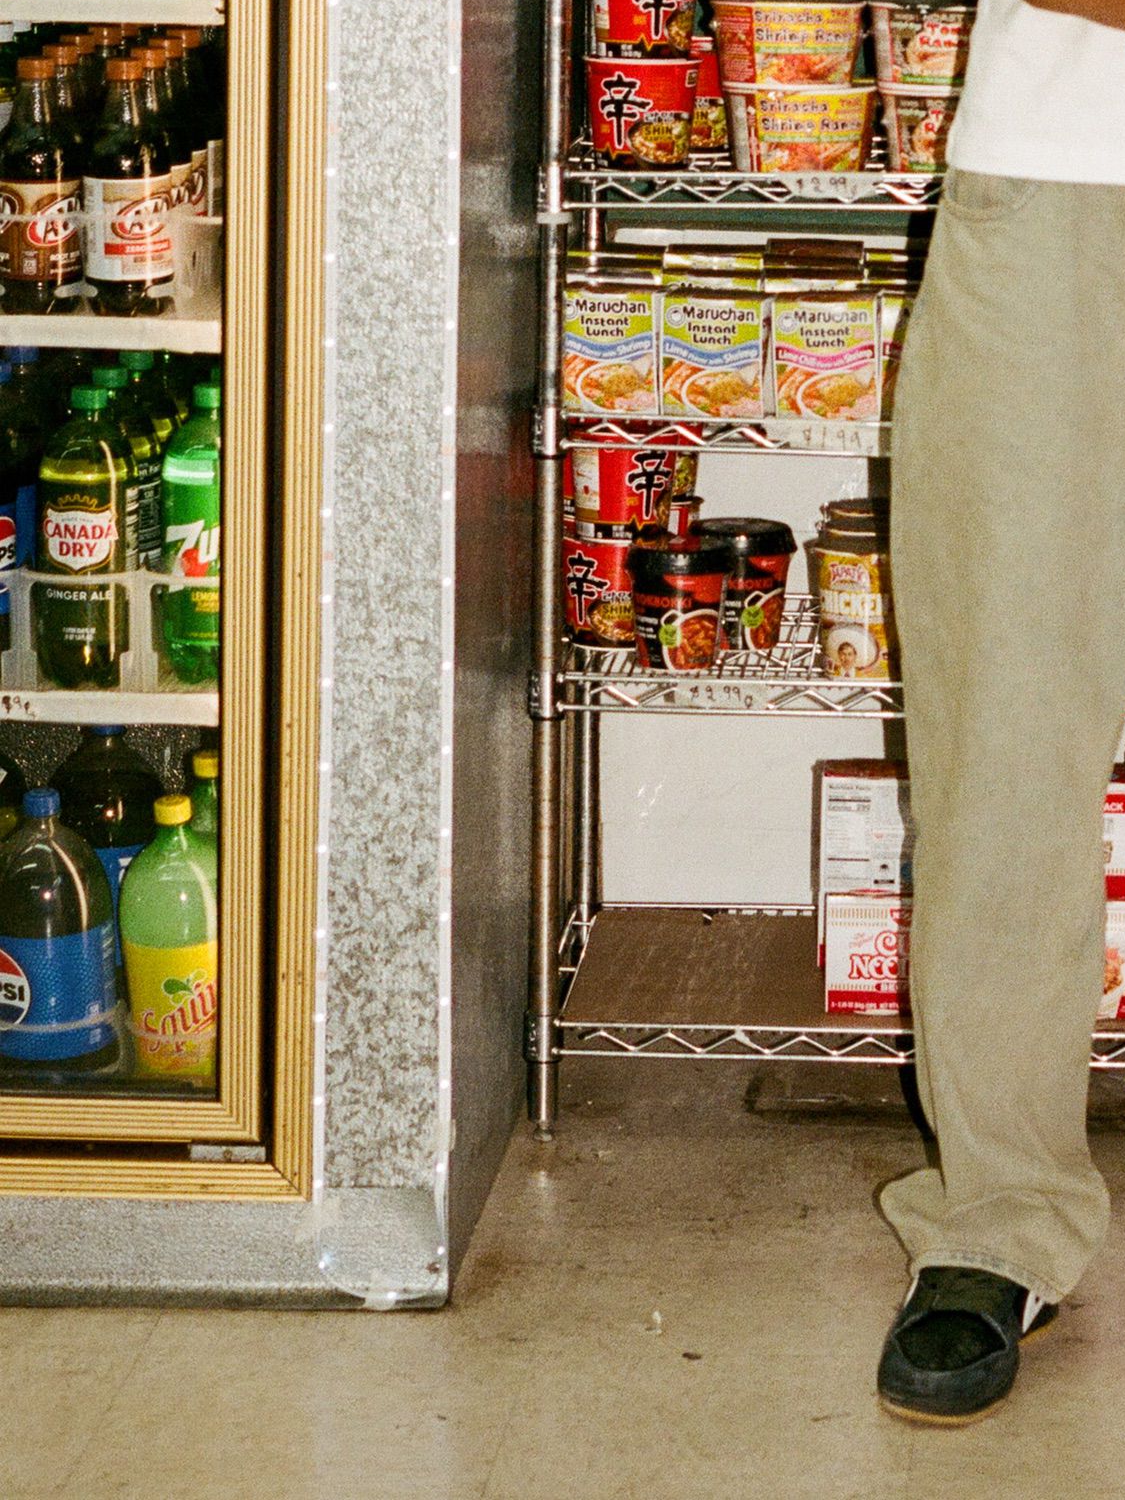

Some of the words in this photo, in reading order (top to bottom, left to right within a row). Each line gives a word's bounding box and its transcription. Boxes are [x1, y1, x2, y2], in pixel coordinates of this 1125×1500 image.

[599, 72, 653, 149] 辛
[643, 124, 675, 137] SHIN
[574, 298, 647, 315] Maruchan
[682, 305, 755, 323] Maruchan
[580, 315, 630, 328] Instant
[794, 310, 869, 324] Maruchan
[586, 327, 625, 338] Lunch
[687, 321, 737, 335] Instant
[800, 326, 851, 338] Instant
[692, 334, 732, 346] Lunch
[805, 337, 846, 349] Lunch
[626, 450, 672, 519] 辛
[43, 518, 119, 541] CANADA
[58, 541, 98, 558] DRY
[165, 520, 219, 592] 7U
[46, 587, 87, 602] GINGER
[90, 589, 111, 601] ALE
[565, 550, 611, 626] 辛
[141, 977, 218, 1054] Squir
